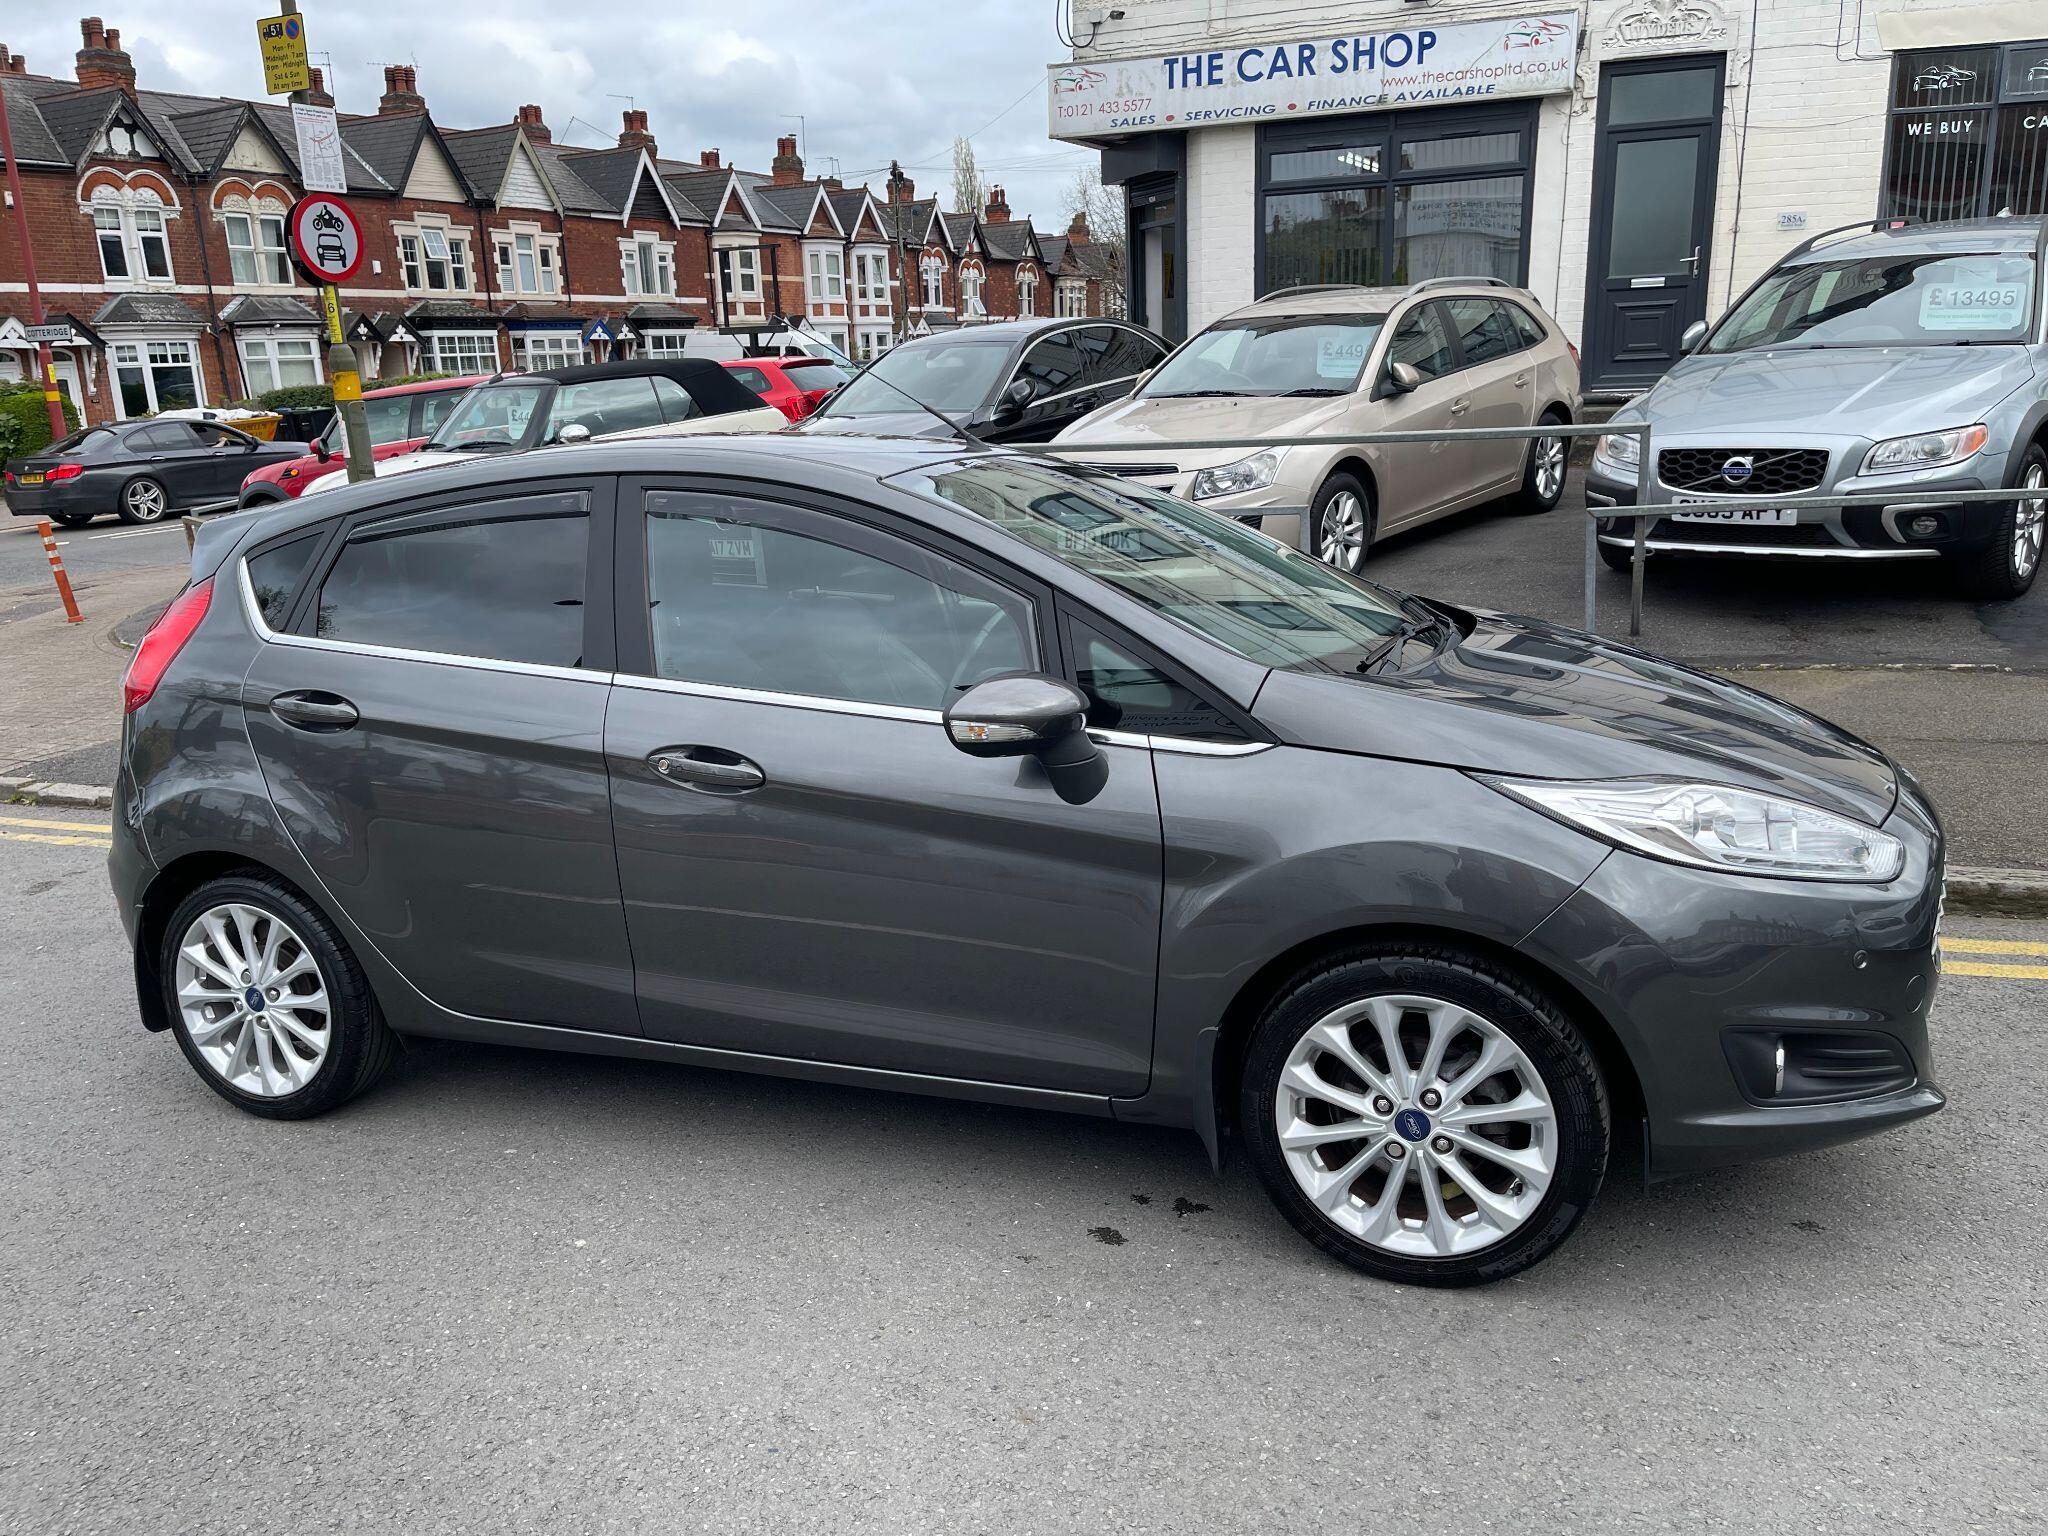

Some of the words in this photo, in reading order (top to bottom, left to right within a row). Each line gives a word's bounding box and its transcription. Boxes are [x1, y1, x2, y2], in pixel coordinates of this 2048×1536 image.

[1163, 53, 1224, 90] THE
[1237, 43, 1317, 83] CAR
[1330, 30, 1437, 74] SHOP
[1380, 58, 1569, 87] www.thecarshopltd.co.uk
[1057, 103, 1094, 118] T:0121
[1098, 101, 1120, 114] 433
[1122, 98, 1152, 113] 5577
[1110, 115, 1156, 128] SALES
[1184, 104, 1276, 121] SERVICING
[1307, 93, 1389, 110] FINANCE
[1394, 84, 1496, 102] AVAILABLE
[1907, 122, 1932, 136] WE
[1939, 119, 1974, 134] BUY
[328, 302, 335, 313] 6
[26, 327, 69, 338] COTTERIDGE
